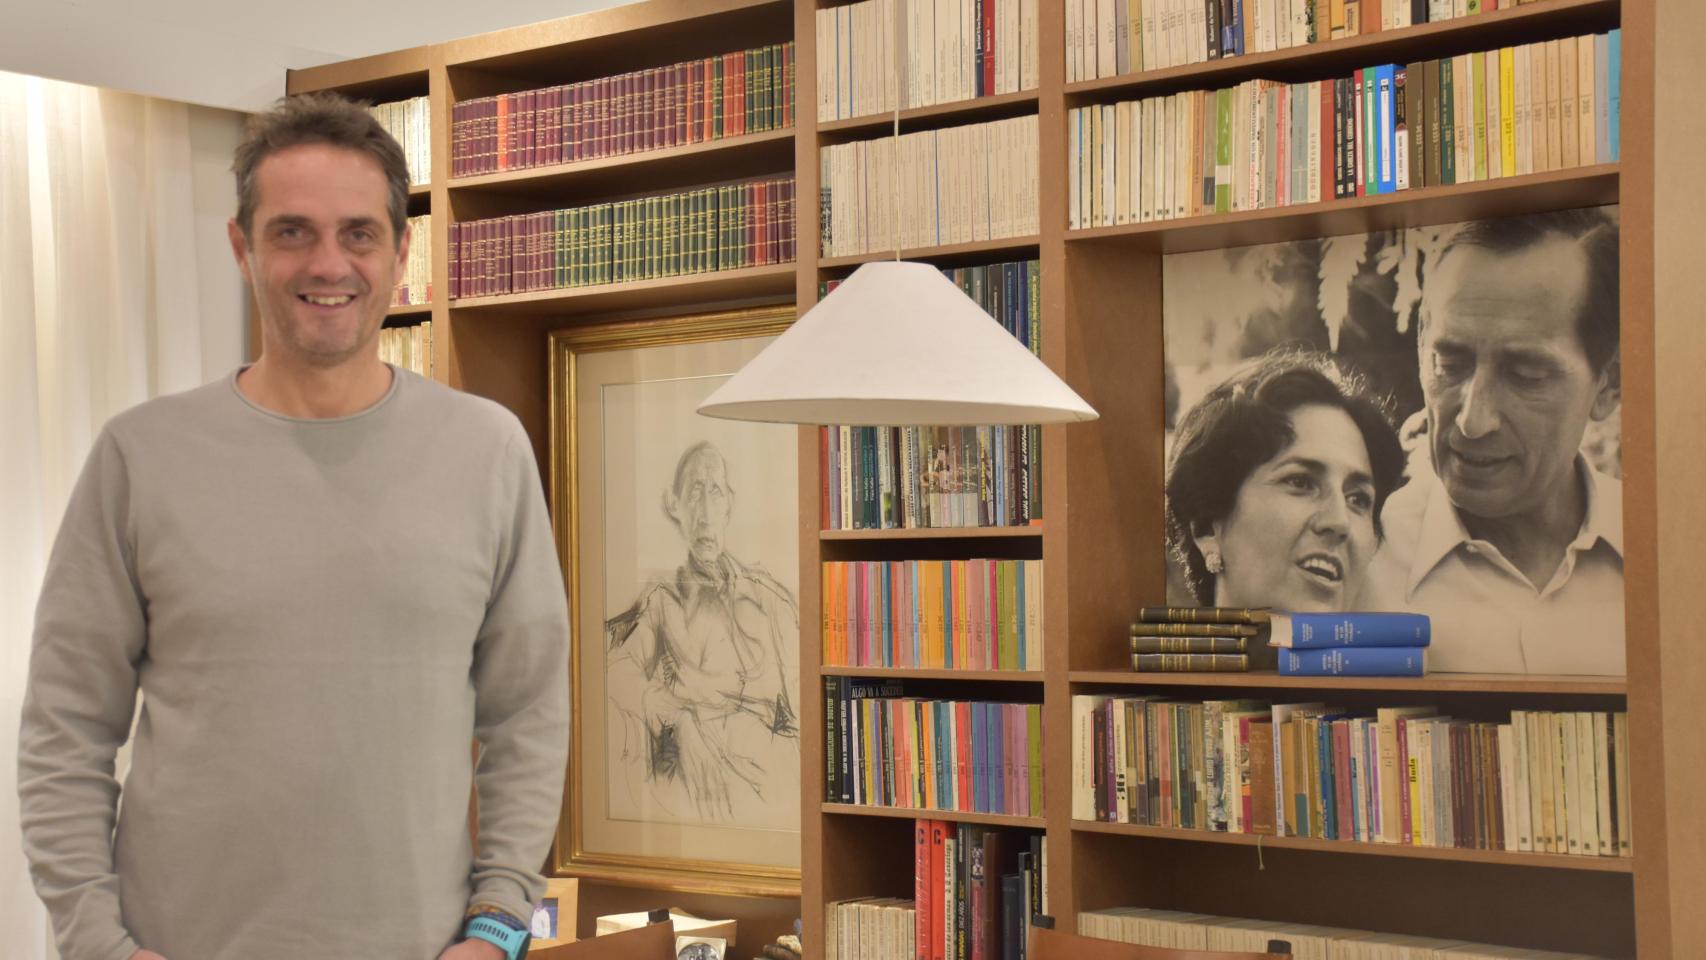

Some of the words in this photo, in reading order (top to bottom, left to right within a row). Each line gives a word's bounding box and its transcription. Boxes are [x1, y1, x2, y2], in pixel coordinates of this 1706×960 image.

[852, 688, 866, 698] ALGO
[867, 688, 874, 697] VA
[1408, 758, 1416, 783] Buda
[918, 828, 925, 844] C
[934, 829, 941, 845] C
